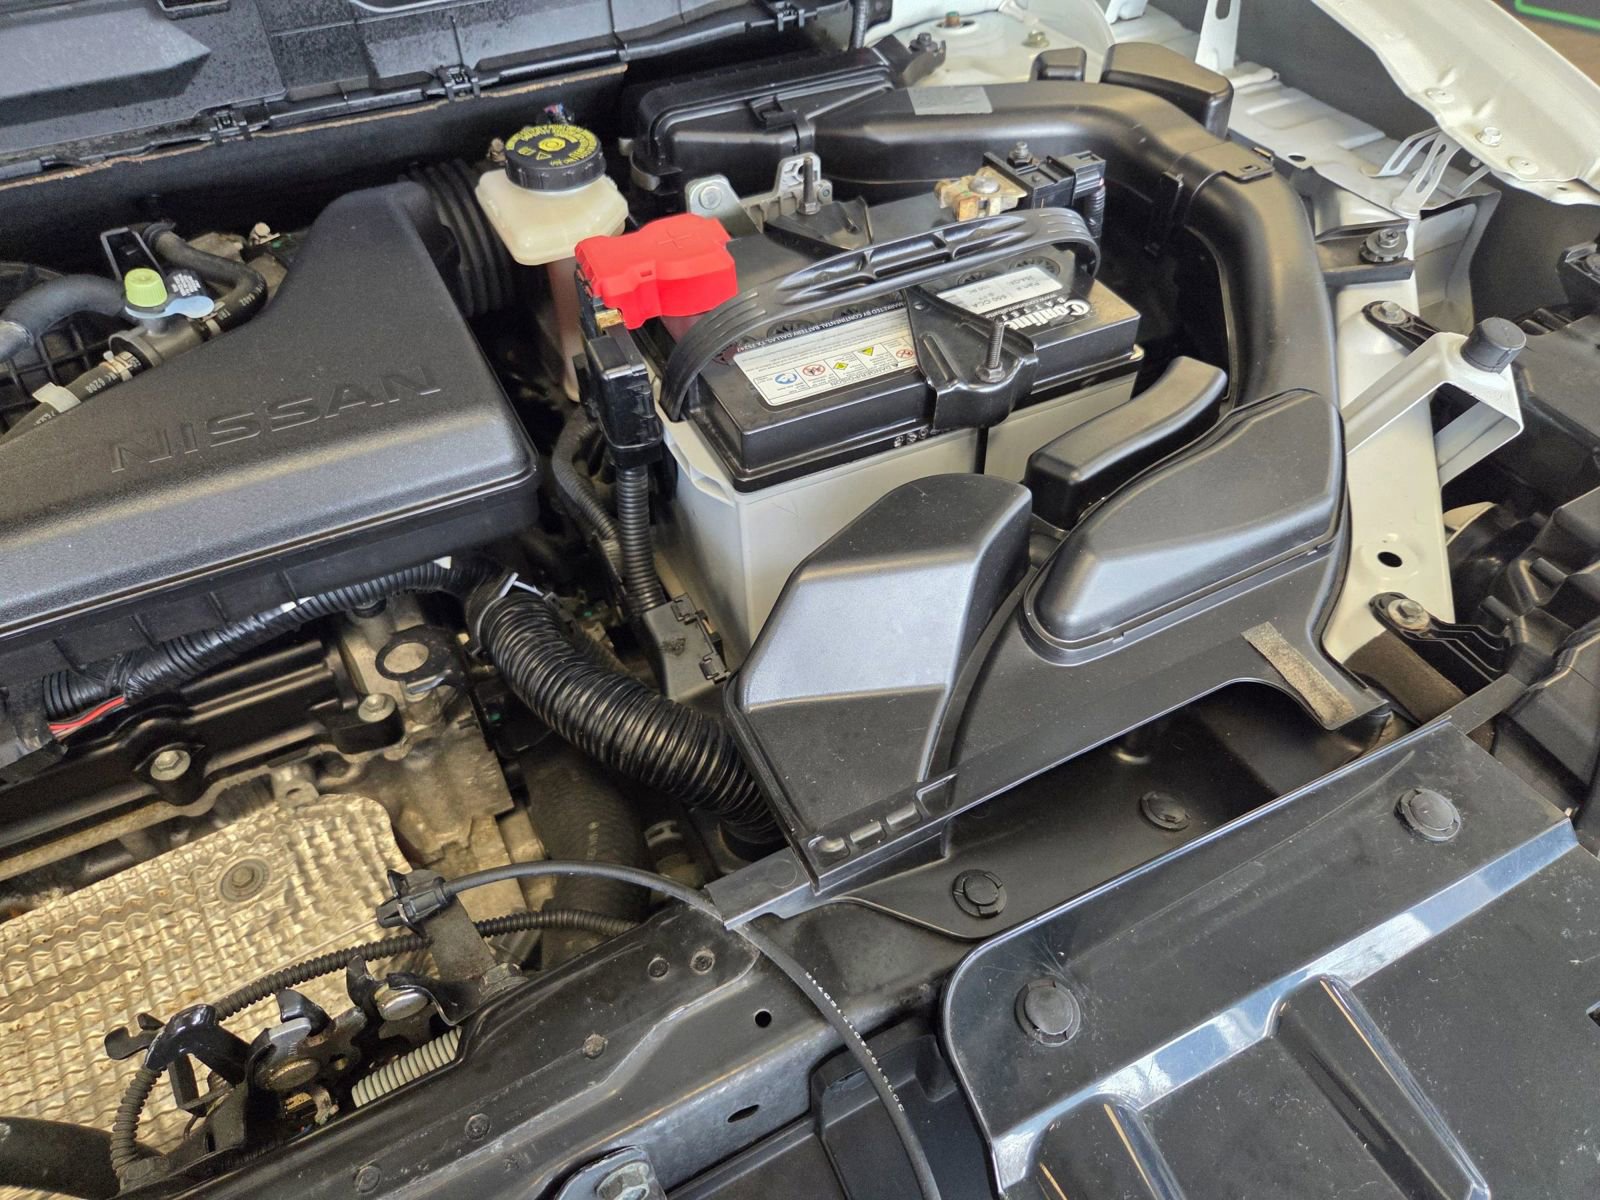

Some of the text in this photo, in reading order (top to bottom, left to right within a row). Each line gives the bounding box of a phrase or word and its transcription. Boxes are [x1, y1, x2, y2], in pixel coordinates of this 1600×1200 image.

[820, 313, 863, 329] CONTINENTAL
[793, 324, 820, 337] BATTERY
[110, 366, 441, 474] NISSAN
